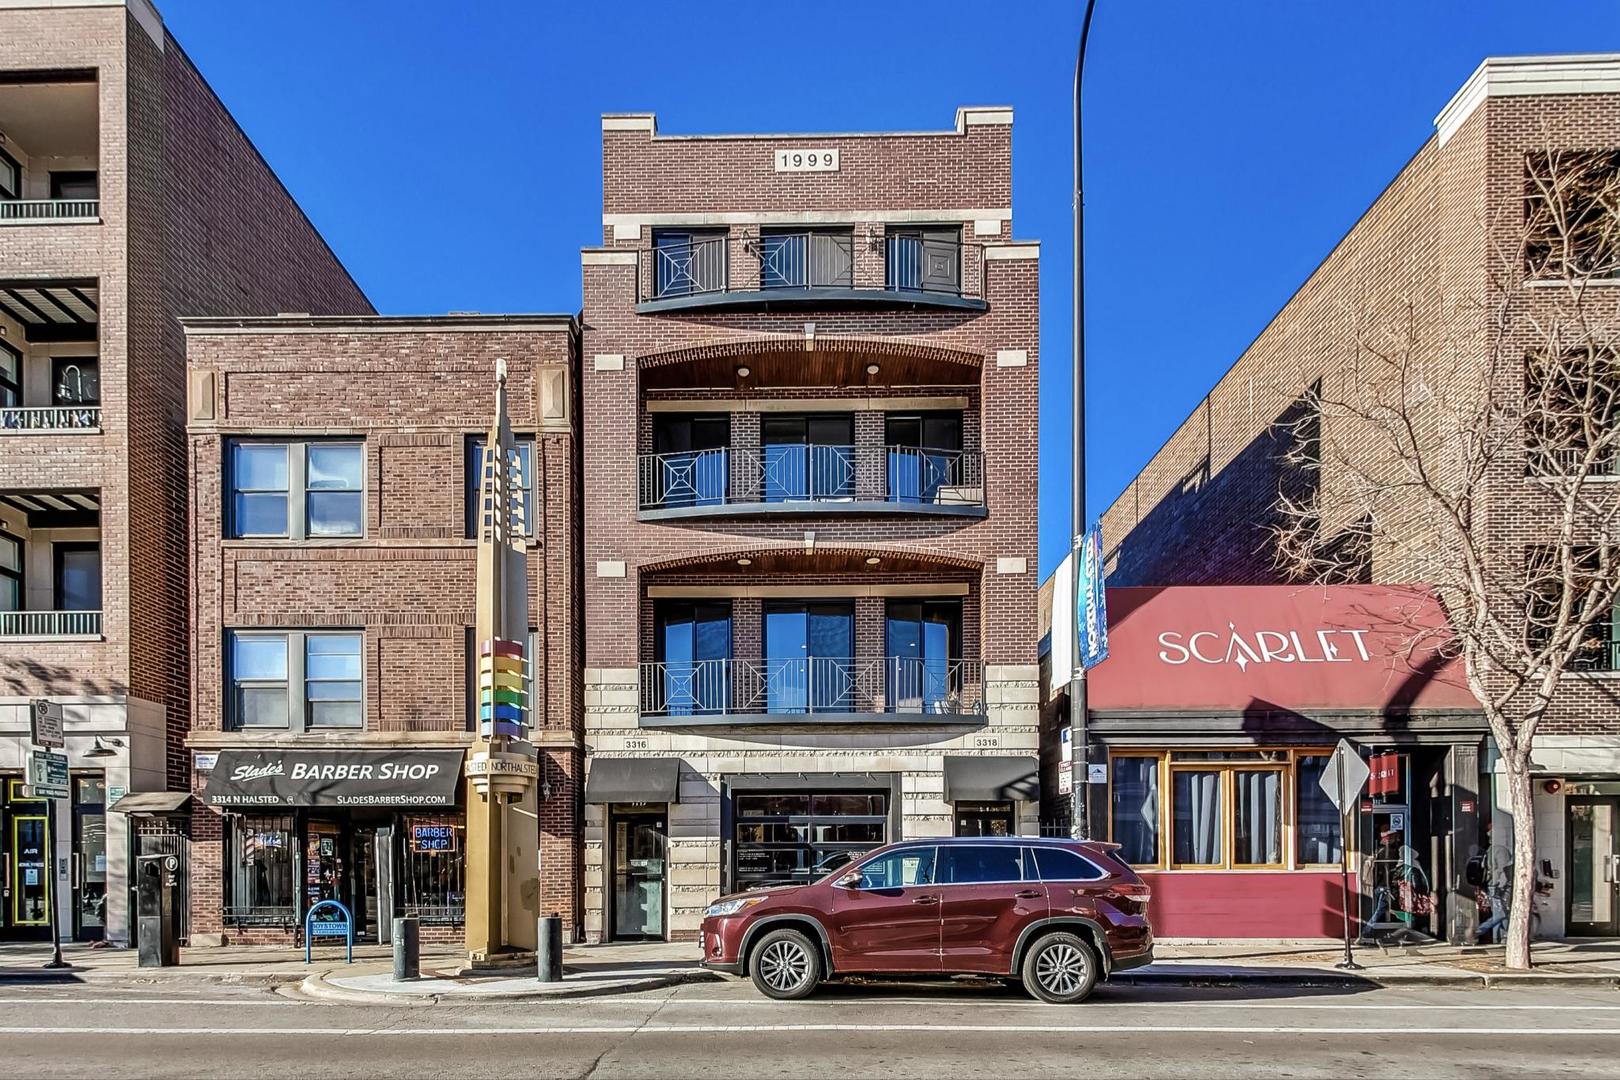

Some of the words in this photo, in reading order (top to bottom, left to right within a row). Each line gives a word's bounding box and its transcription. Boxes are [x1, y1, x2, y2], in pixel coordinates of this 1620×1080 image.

[781, 153, 833, 167] 1999
[1158, 629, 1370, 665] SCARLET
[625, 740, 647, 749] 3316
[976, 738, 998, 747] 3318
[230, 760, 285, 782] Slade's
[290, 763, 373, 780] BARBER
[378, 762, 440, 780] SHOP
[211, 795, 232, 804] 3314
[233, 795, 240, 804] N
[242, 795, 280, 804] HALSTED
[415, 827, 453, 838] BARBER
[421, 839, 448, 849] SHOP
